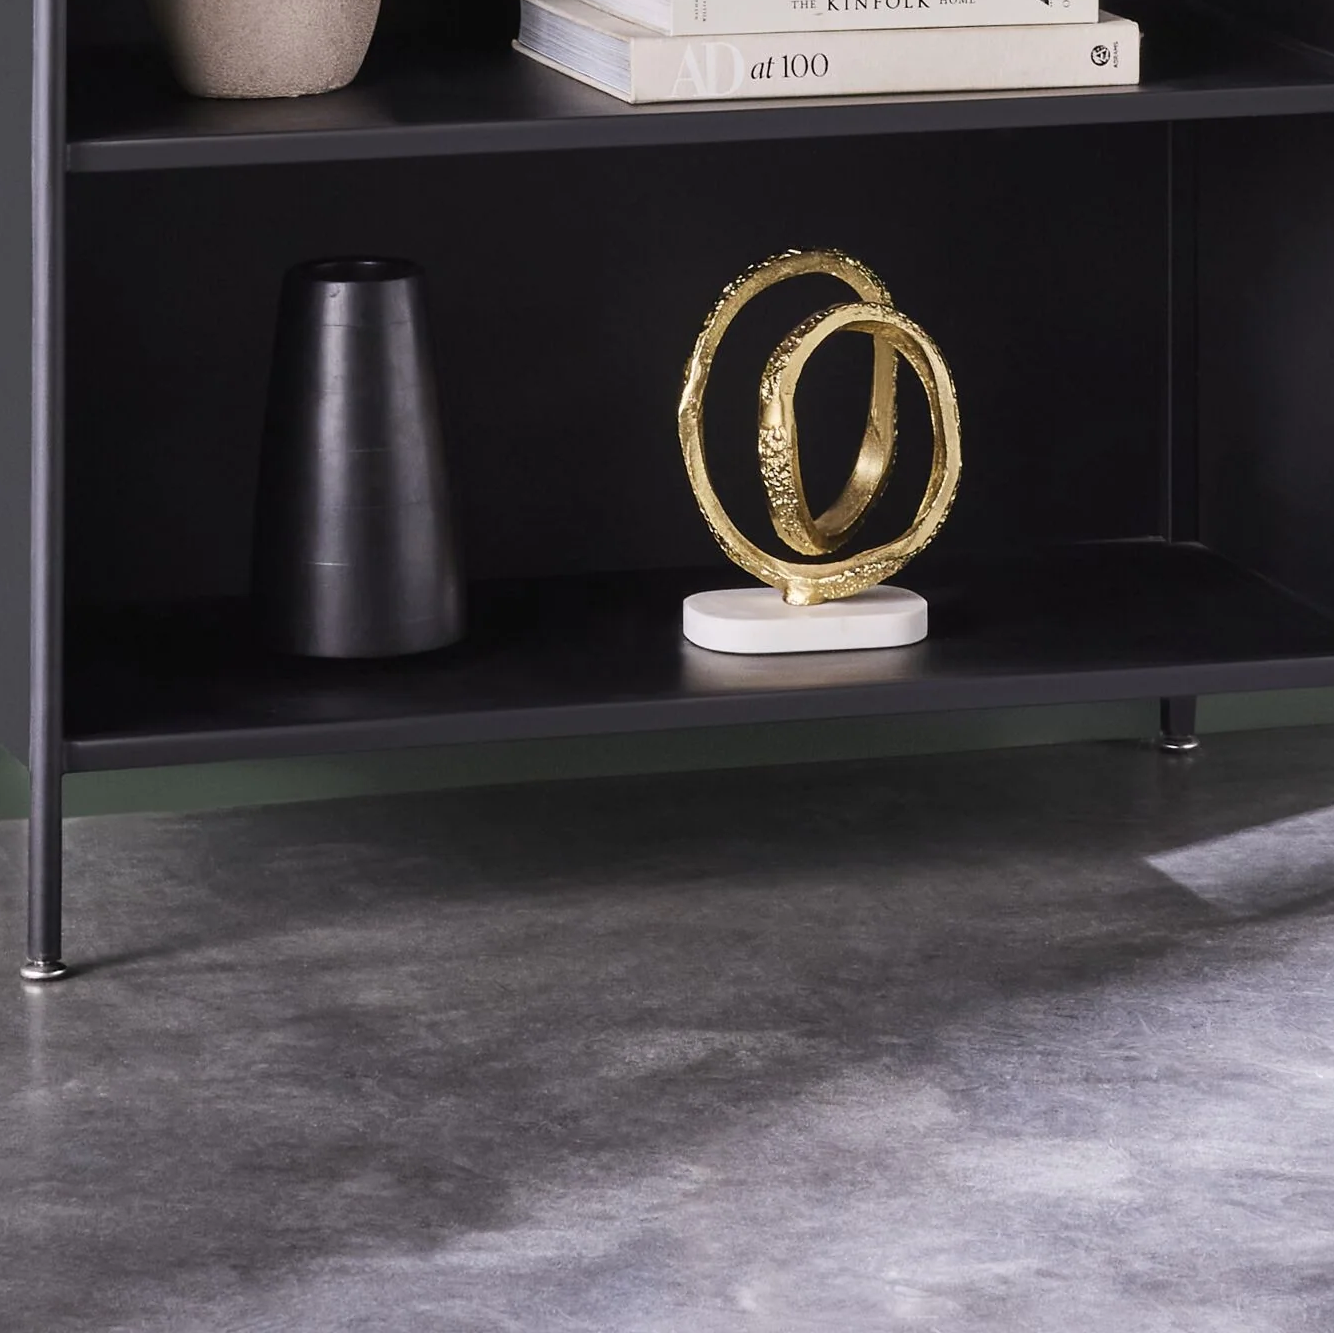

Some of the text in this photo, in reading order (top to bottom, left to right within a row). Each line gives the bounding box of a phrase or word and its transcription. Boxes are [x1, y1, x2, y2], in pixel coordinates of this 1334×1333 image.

[791, 0, 817, 10] THE
[670, 41, 829, 99] AD at 100
